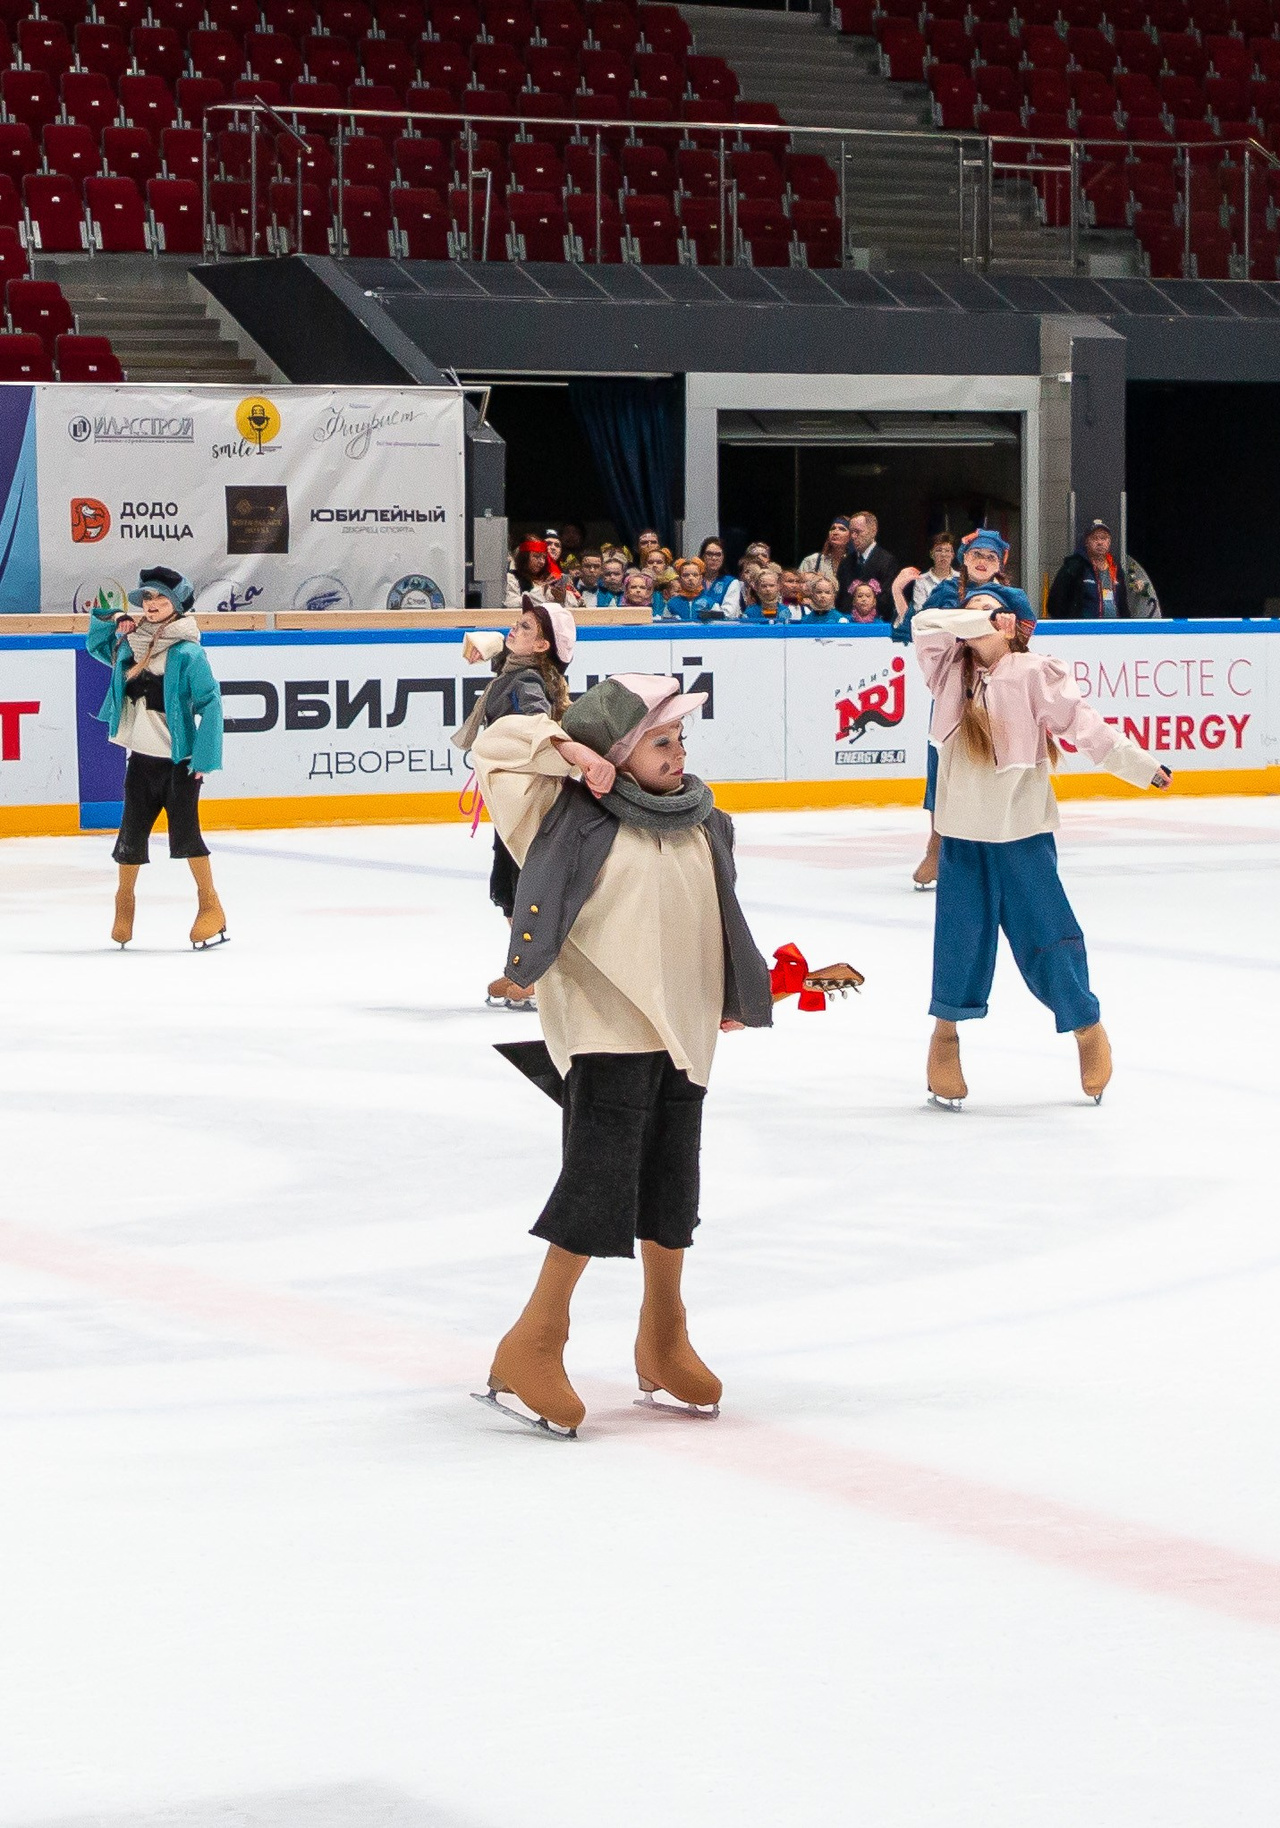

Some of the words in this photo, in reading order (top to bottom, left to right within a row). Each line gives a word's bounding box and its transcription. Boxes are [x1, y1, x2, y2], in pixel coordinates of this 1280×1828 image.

[119, 501, 178, 520] ДОДО
[310, 504, 446, 523] ЮБИЛЕЙНЫЙ
[120, 524, 194, 541] ПИЦЦА
[1074, 659, 1214, 698] ВМЕСТЕ
[308, 750, 452, 780] ДВОРЕЦ
[837, 751, 880, 764] ENERGY
[880, 750, 904, 763] 95.0
